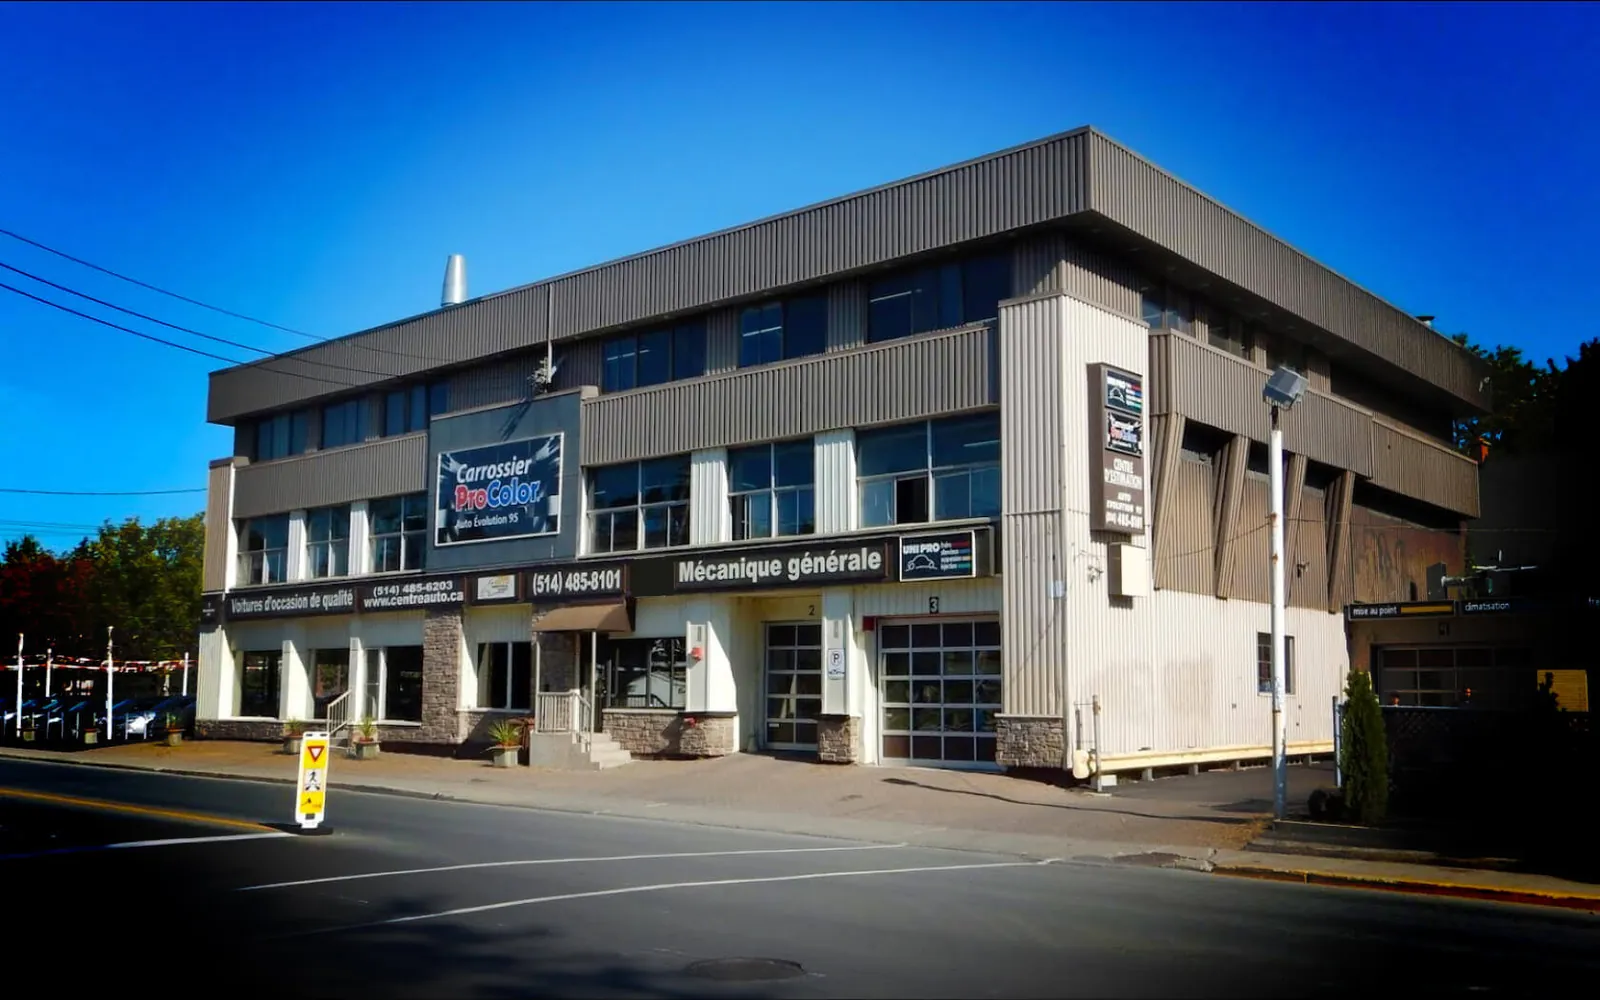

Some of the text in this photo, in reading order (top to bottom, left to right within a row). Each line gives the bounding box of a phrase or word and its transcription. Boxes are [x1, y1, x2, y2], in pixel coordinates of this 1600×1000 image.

[456, 455, 532, 483] Carrossier
[454, 477, 541, 512] ProColor
[455, 512, 519, 529] Auto Évolution 95
[903, 544, 919, 554] UNI
[920, 542, 940, 554] PRO
[678, 547, 882, 583] Mécanique générale
[373, 580, 454, 597] (514) 485-6203
[532, 572, 563, 596] (514)
[565, 569, 621, 592] 485-8101
[231, 598, 264, 613] Voitures
[264, 594, 308, 611] d'occasion
[309, 592, 321, 608] de
[322, 589, 354, 611] qualité
[363, 591, 465, 608] www.centreauto.ca
[930, 598, 938, 612] 3
[808, 604, 815, 615] 2
[1369, 607, 1378, 616] au
[1379, 605, 1397, 618] point
